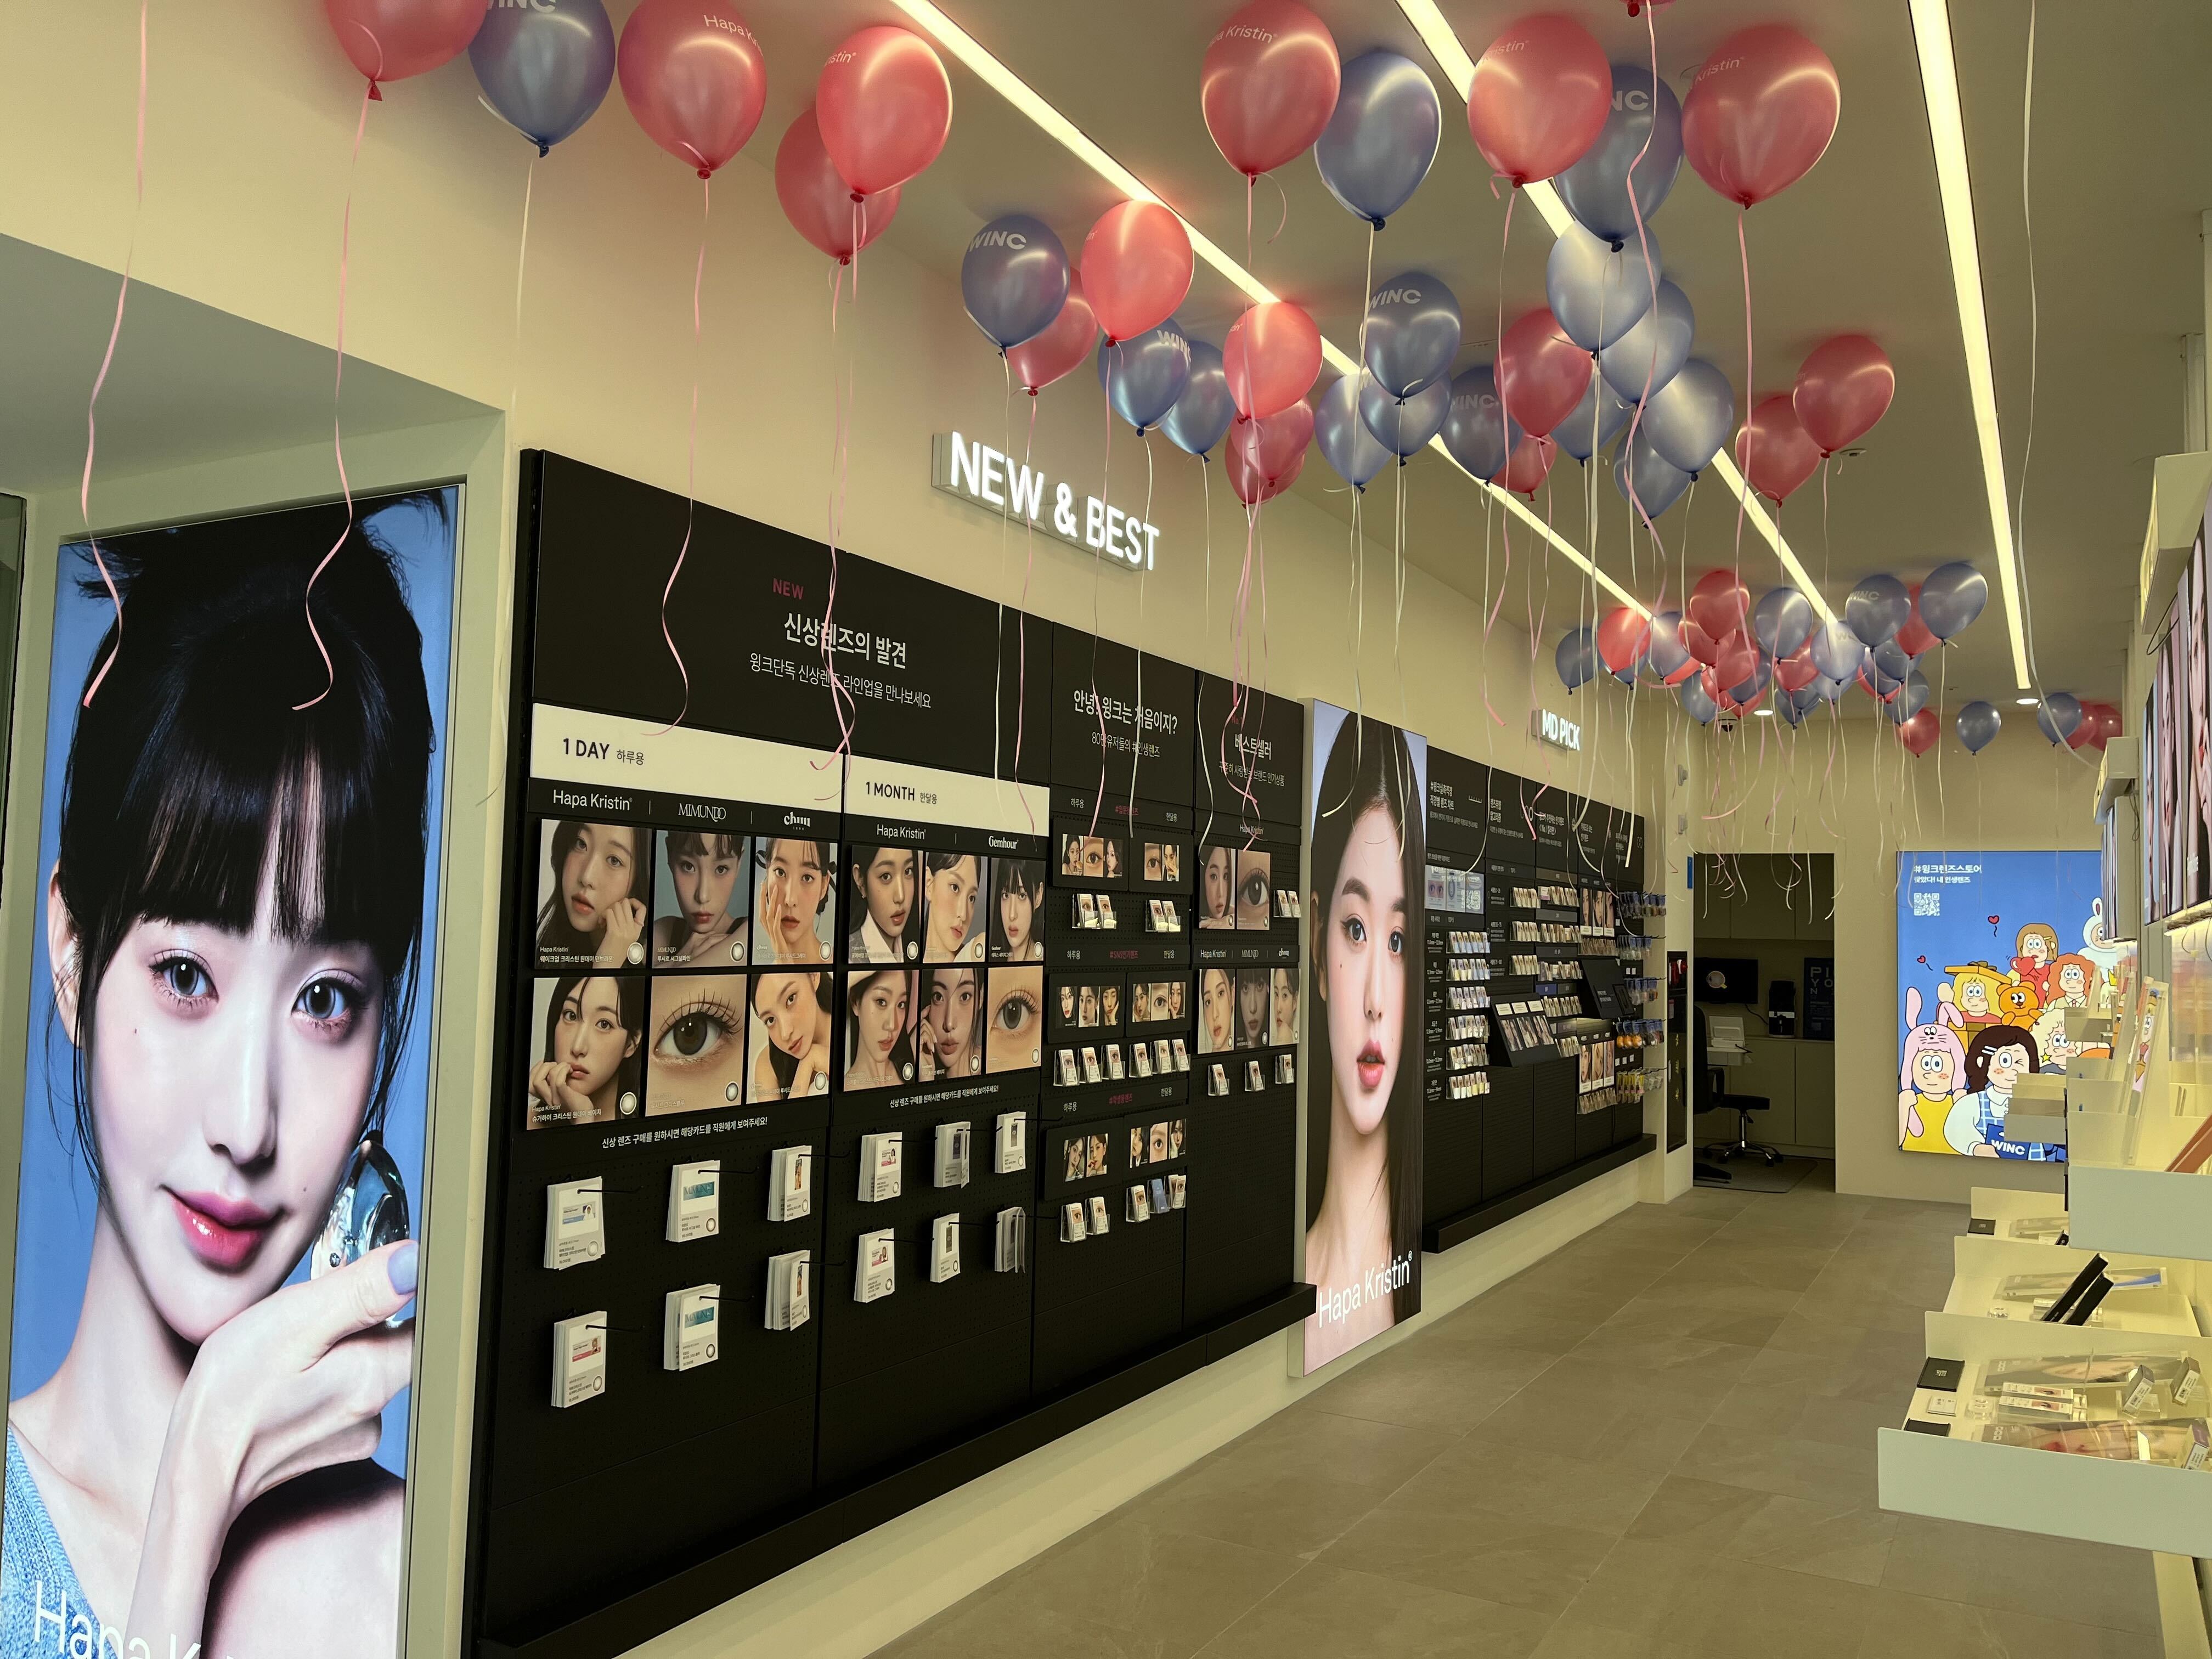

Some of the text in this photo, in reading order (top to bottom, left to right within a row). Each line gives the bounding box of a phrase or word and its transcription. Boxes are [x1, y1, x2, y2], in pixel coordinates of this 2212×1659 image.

[703, 15, 745, 37] Hapa
[1226, 25, 1273, 43] Kristin
[1610, 90, 1649, 111] NC
[968, 231, 1026, 252] WINC
[1367, 289, 1422, 308] WINC
[951, 431, 1160, 571] NEW & BEST
[772, 578, 804, 600] NEW
[876, 636, 906, 669] 발견
[750, 652, 795, 680] 윙크단독
[843, 675, 883, 699] 라인업을
[885, 685, 931, 708] 만나보세요
[1102, 697, 1132, 724] 윙크는
[1135, 706, 1178, 735] 처음이지?
[1542, 709, 1580, 751] MD PICK
[563, 738, 645, 765] 1 DAY 하루용
[1235, 733, 1272, 760] 베스트셀러
[553, 789, 630, 810] Hapa Kristin
[866, 782, 938, 805] 1 MONTH 한달용
[1070, 798, 1085, 809] 하루용
[678, 803, 727, 822] MIMUNDO
[877, 824, 925, 840] Hapa Kristin
[988, 836, 1018, 849] Gemhour
[1914, 864, 1983, 874] #윙크렌즈스토어
[1067, 950, 1081, 960] 하루용
[1200, 950, 1226, 958] Hapa Kristin
[552, 1111, 572, 1120] 크리스틴
[602, 1116, 768, 1149] 신상 렌즈 구매를 원하시면 해당카드를 직원에게 보여주세요!
[1991, 1139, 2025, 1155] WINC
[1319, 1255, 1410, 1328] Hapa Kristin
